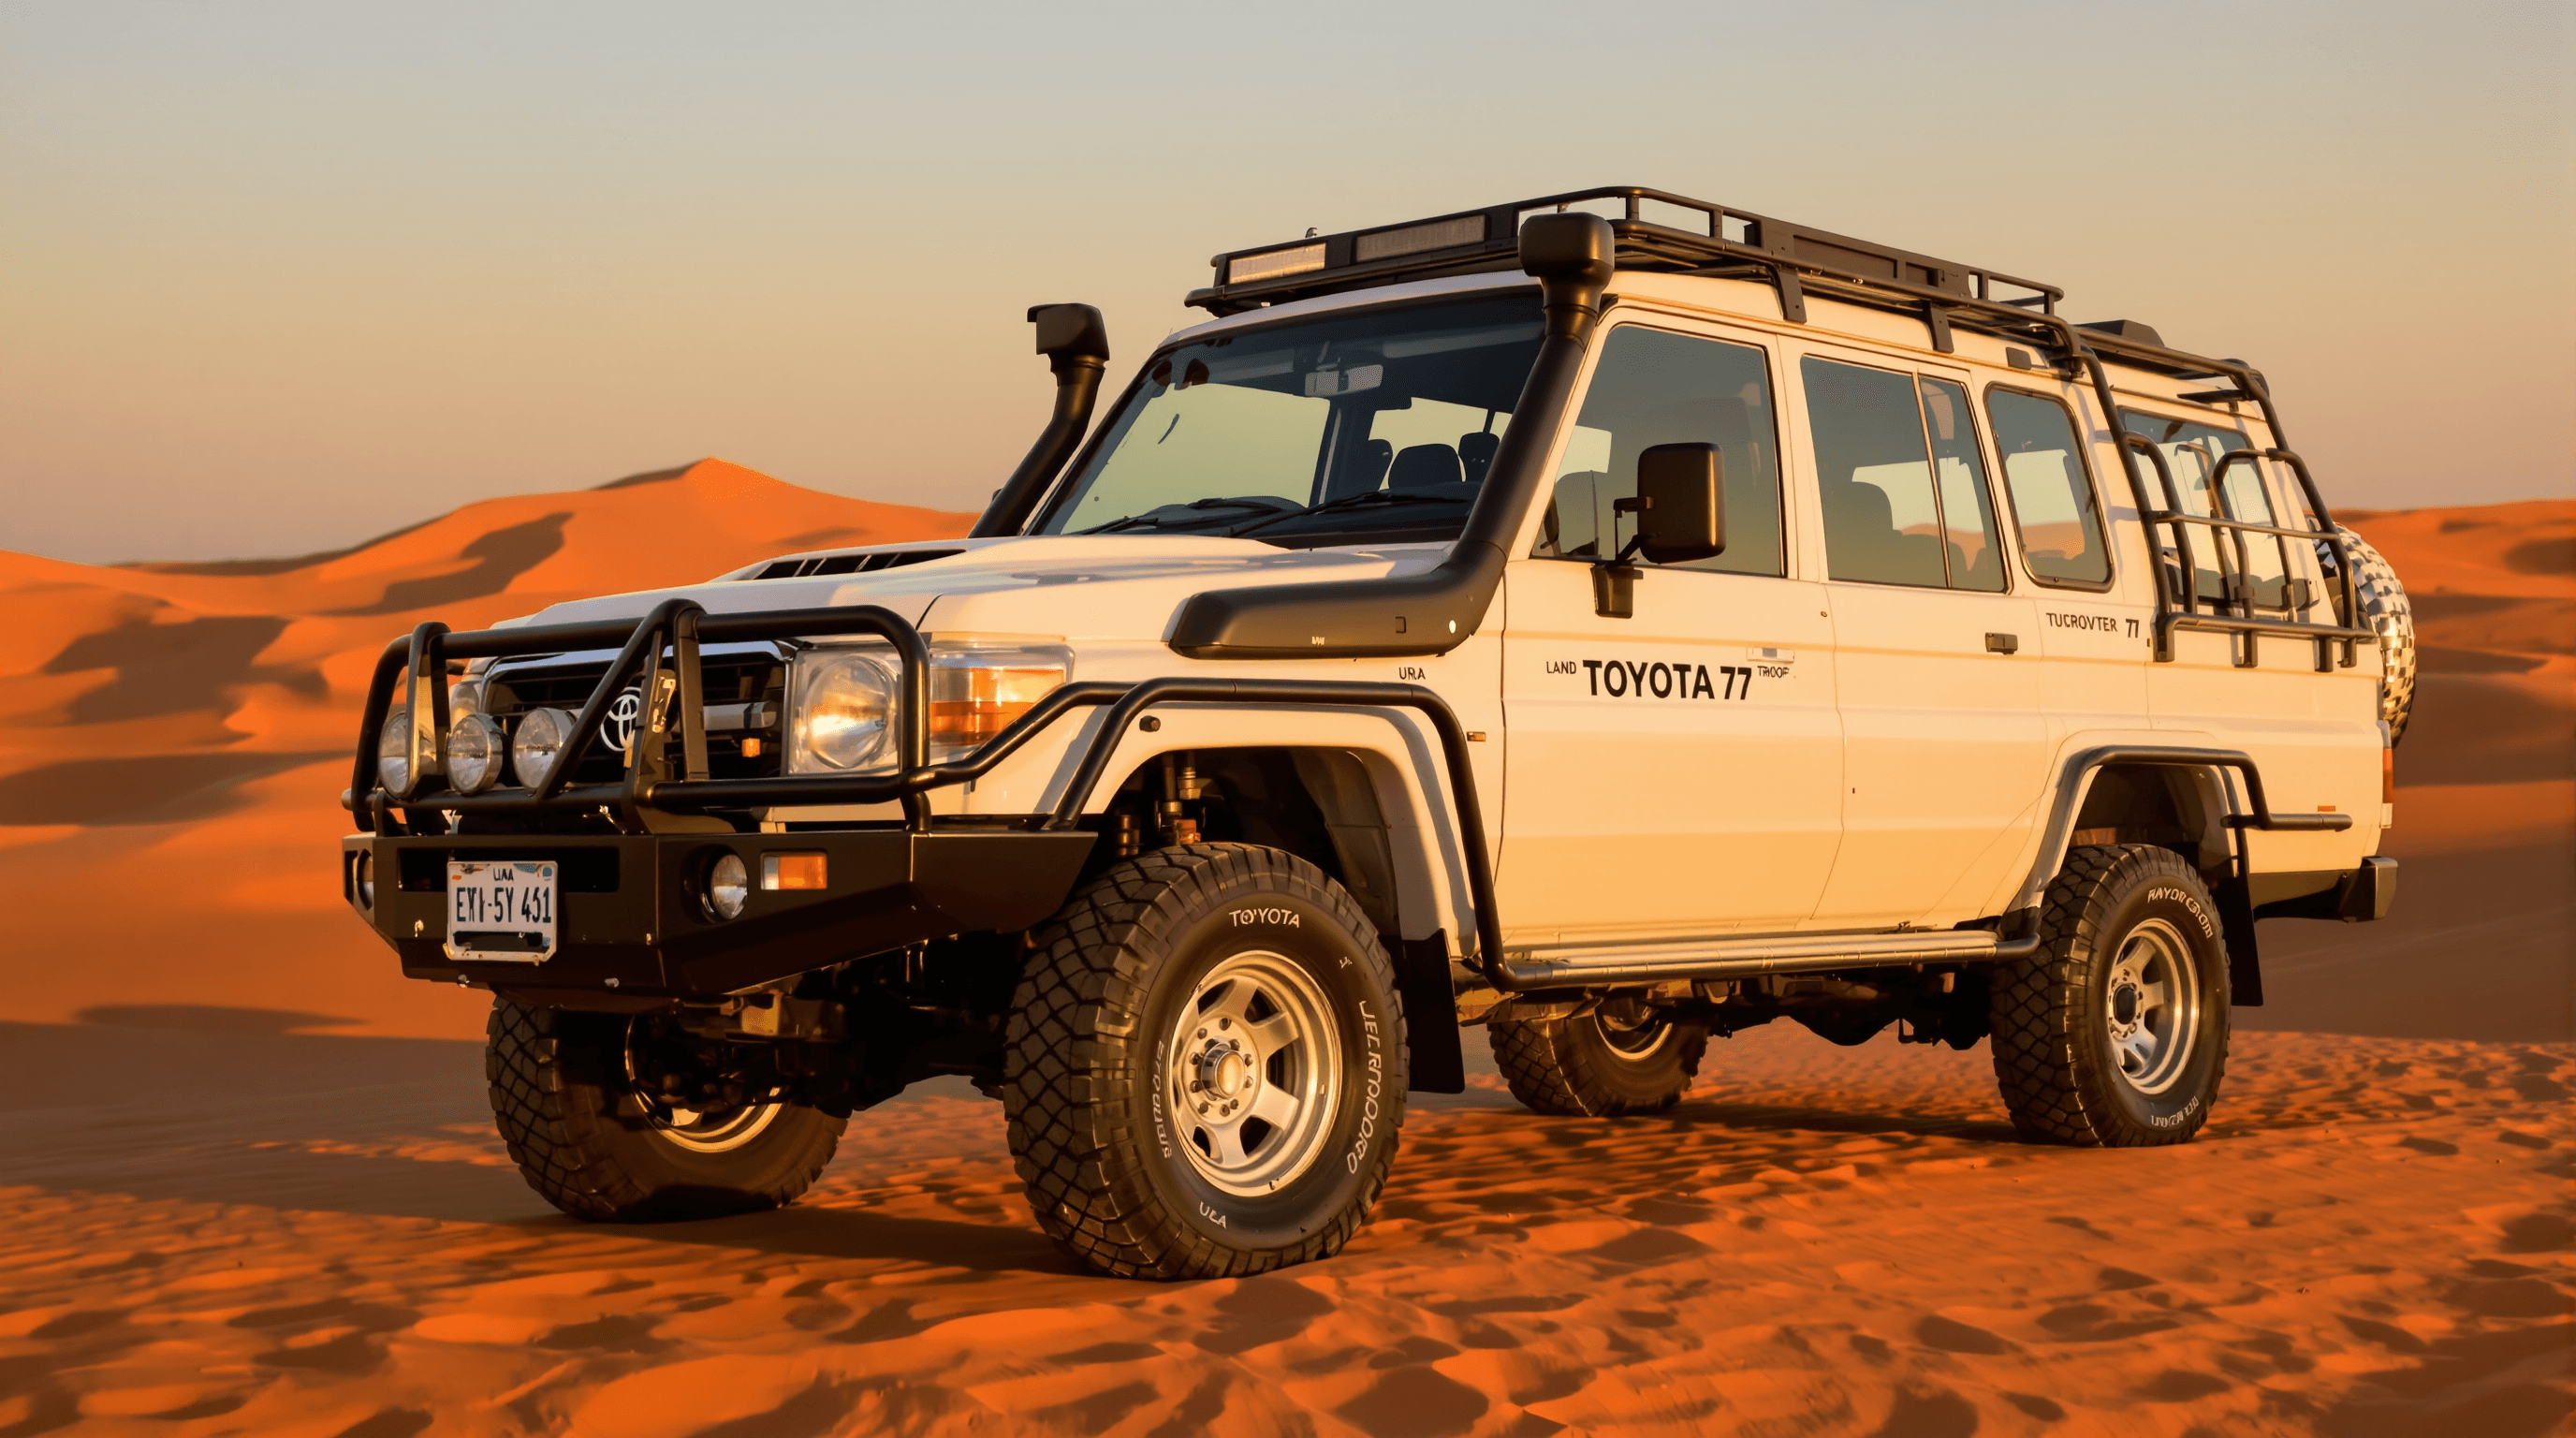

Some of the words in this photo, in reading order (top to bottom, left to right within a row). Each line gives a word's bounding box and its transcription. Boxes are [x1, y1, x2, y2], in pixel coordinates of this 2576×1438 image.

[2126, 618, 2140, 638] 77
[1546, 661, 1577, 675] LAND
[1582, 659, 1715, 700] TOYOTA
[1720, 666, 1752, 700] 77
